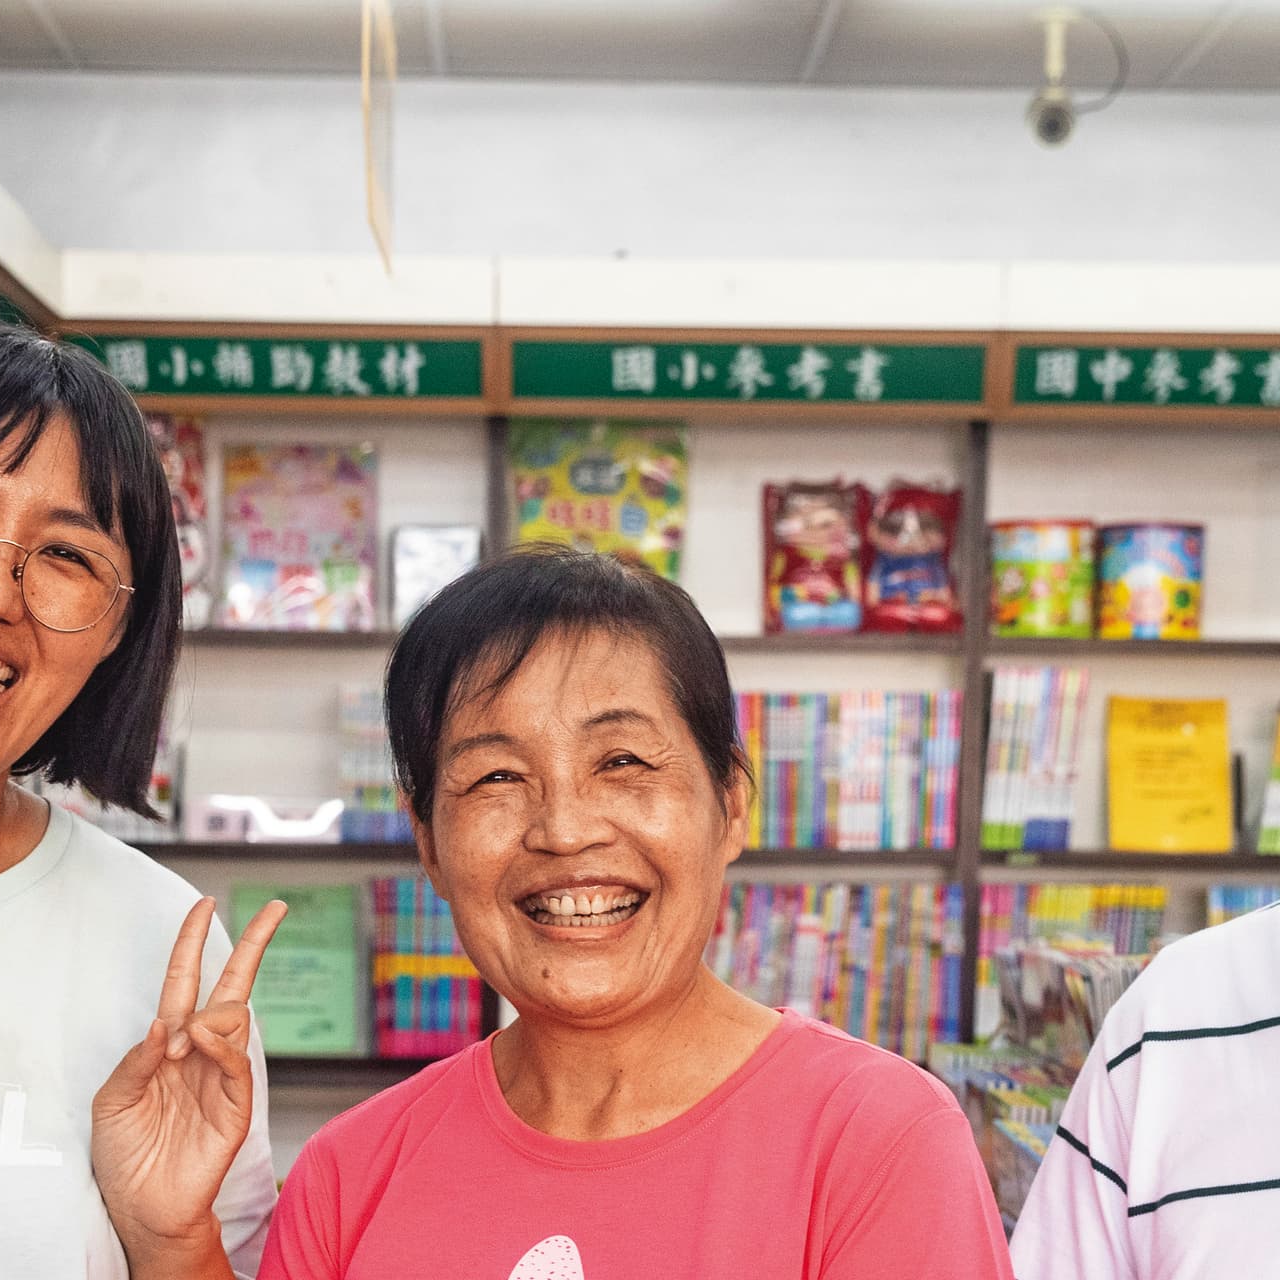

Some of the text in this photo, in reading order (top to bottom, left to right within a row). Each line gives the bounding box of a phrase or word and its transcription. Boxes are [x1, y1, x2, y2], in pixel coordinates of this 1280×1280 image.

[108, 340, 426, 396] 國小輔助教材
[611, 345, 891, 401] 國小參考書
